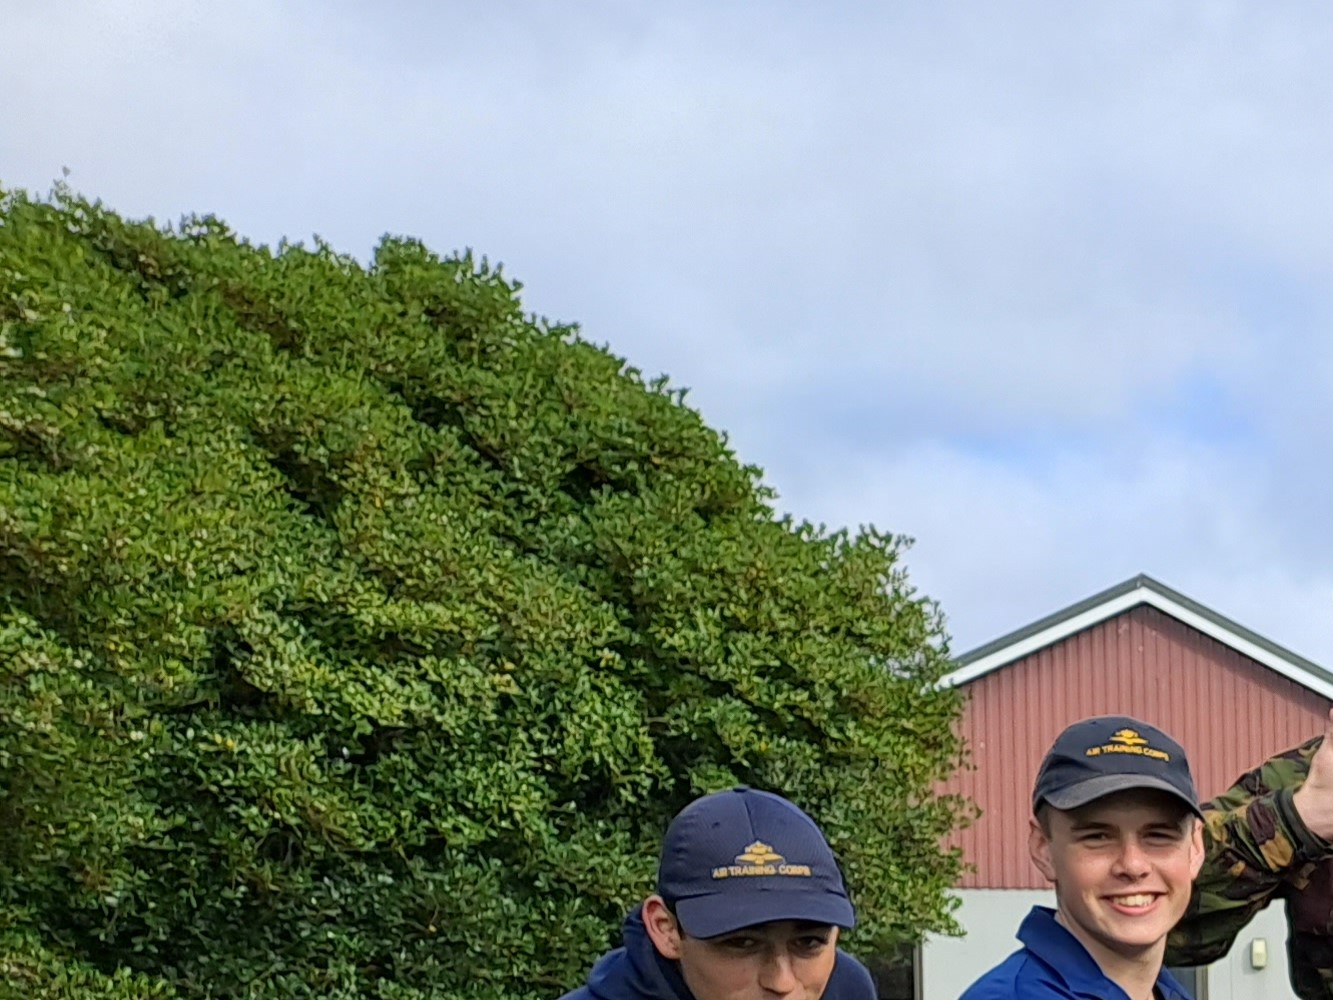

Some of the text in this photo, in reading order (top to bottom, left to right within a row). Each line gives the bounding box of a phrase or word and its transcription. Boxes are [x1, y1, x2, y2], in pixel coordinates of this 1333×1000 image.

[1101, 744, 1143, 754] TRAINING
[712, 865, 812, 879] AIR TRAINING CORPS
